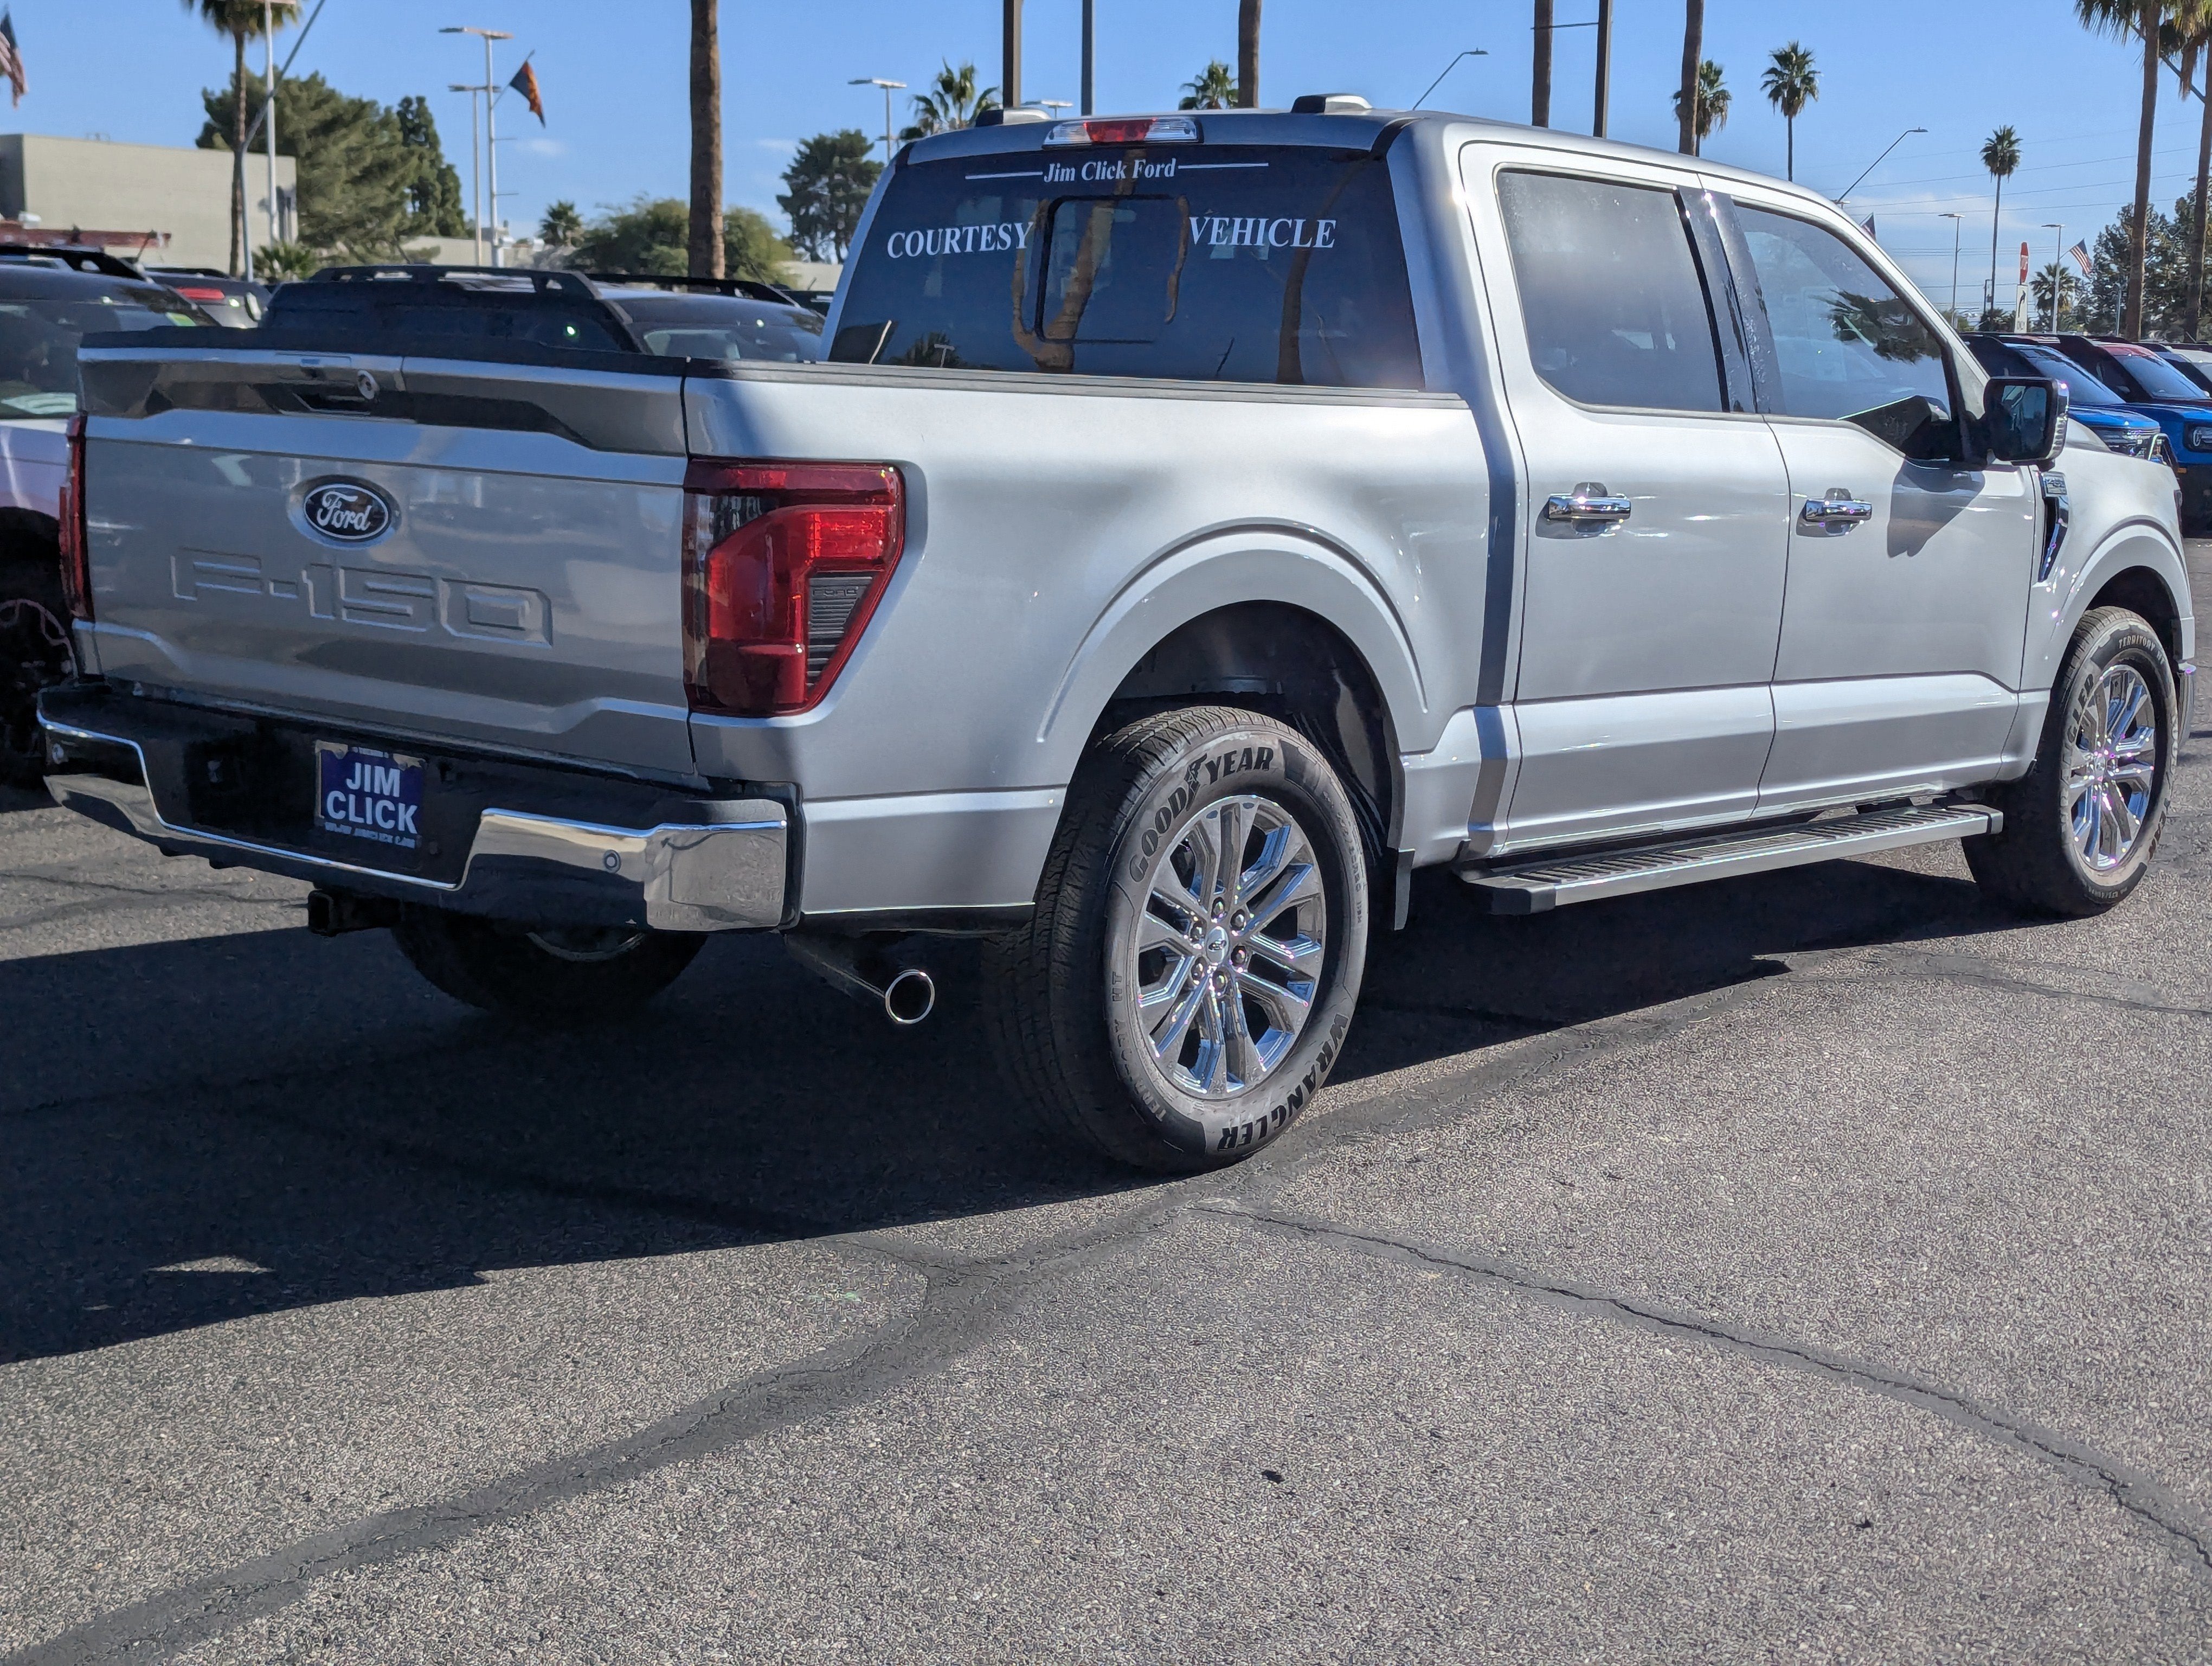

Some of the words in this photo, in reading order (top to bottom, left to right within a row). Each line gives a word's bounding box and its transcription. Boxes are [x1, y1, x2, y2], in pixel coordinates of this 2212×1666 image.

[1044, 163, 1076, 183] Jim
[1081, 160, 1127, 181] Click
[1131, 158, 1176, 179] Ford
[887, 221, 1034, 259] COURTESY
[1188, 216, 1337, 248] VEHICLE
[317, 491, 373, 531] Ford
[169, 544, 554, 649] F-150
[2118, 634, 2156, 651] TERRITORY
[345, 762, 401, 797] JIM
[326, 790, 418, 834] CLICK
[1129, 746, 1274, 883] GOODYEAR
[1217, 1014, 1349, 1152] WRANGLER
